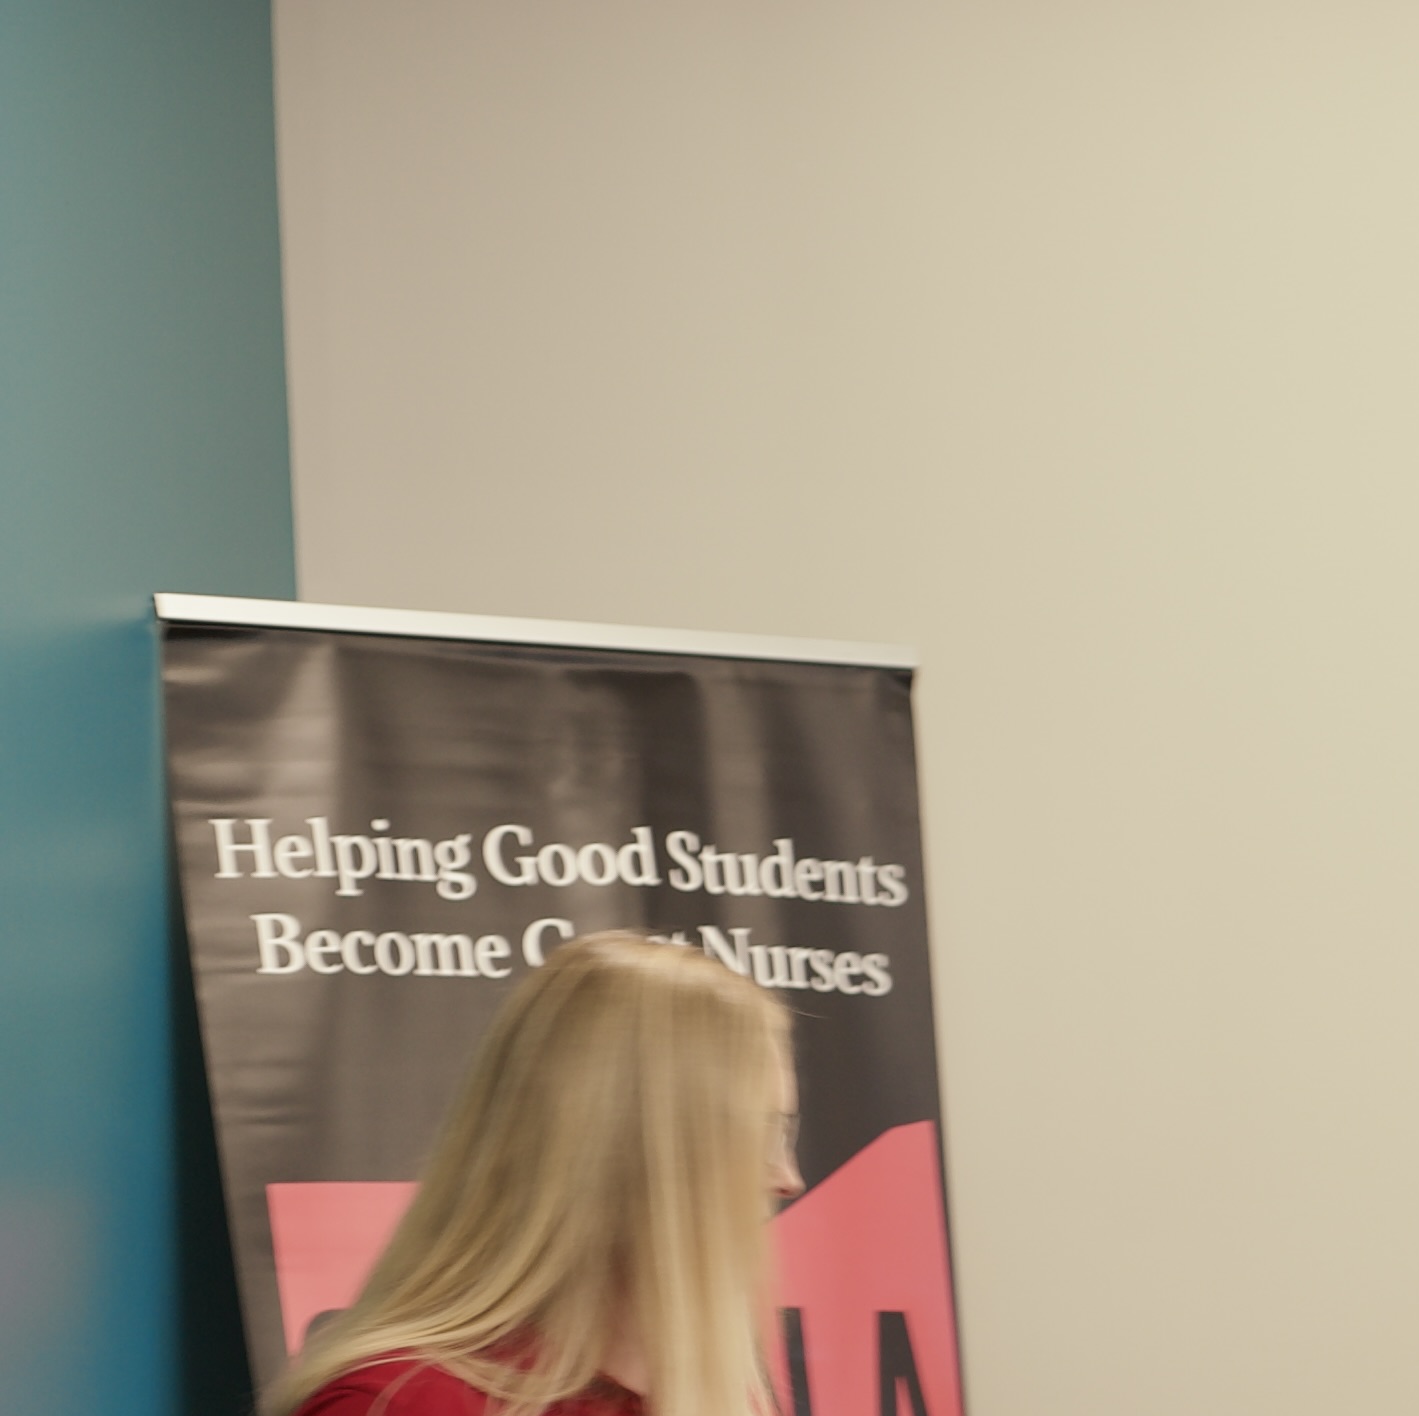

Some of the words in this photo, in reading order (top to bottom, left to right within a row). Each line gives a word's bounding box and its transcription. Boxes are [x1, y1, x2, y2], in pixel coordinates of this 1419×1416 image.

[208, 817, 478, 900] Helping
[482, 824, 662, 887] Good
[665, 829, 910, 908] Students
[249, 912, 513, 979] Become
[698, 924, 893, 996] Nurses
